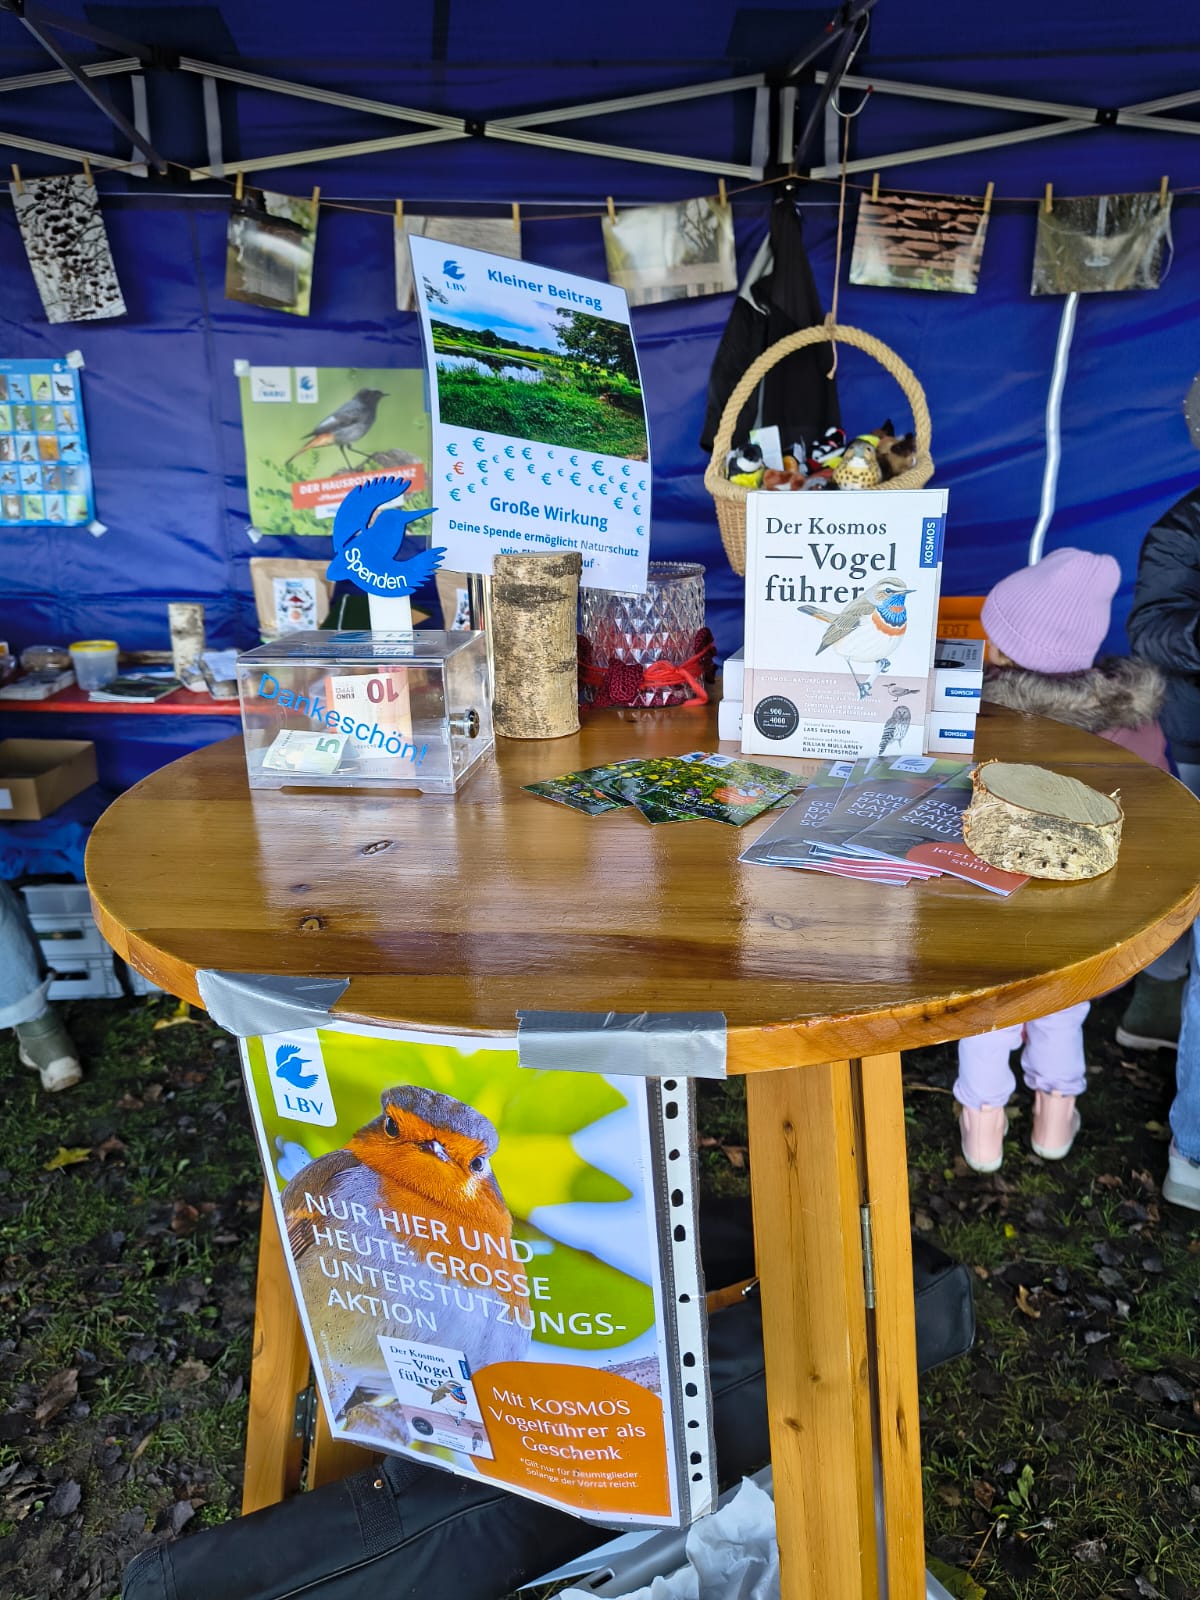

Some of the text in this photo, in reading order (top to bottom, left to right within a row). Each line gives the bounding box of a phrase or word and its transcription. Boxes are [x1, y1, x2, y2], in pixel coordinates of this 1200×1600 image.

[487, 268, 603, 312] Kleiner Beitrag
[490, 497, 608, 533] Große Wirkung
[765, 517, 887, 535] Der Kosmos
[449, 519, 639, 557] Deine Spende ermöglicht Naturschutz
[923, 521, 936, 565] KOSMOS
[345, 547, 407, 590] Spenden
[582, 558, 595, 568] uf
[808, 543, 897, 579] Vogel
[765, 574, 865, 604] führer
[366, 678, 399, 704] 10
[257, 672, 429, 767] Dankeschön!
[315, 738, 340, 753] 5
[857, 797, 903, 809] BAYE
[917, 804, 961, 820] BAYE
[898, 815, 962, 837] SCHÜT
[908, 809, 962, 828] NATU
[284, 1094, 324, 1116] LBV
[304, 1191, 534, 1263] NUR HIER UND
[312, 1224, 552, 1301] HEUTE: GROSSE
[319, 1256, 627, 1336] UNTERSTÜTZUNGS-
[327, 1287, 438, 1333] AKTION
[389, 1345, 446, 1363] Der Kosmos
[398, 1368, 443, 1387] führer
[412, 1359, 455, 1378] Vogel
[492, 1386, 632, 1417] Mit KOSMOS
[487, 1405, 646, 1439] Vogelführer als
[521, 1435, 624, 1461] Geschenk
[526, 1468, 639, 1488] Solange der Vorrat reicht.
[540, 1464, 555, 1473] nur
[557, 1467, 570, 1476] für
